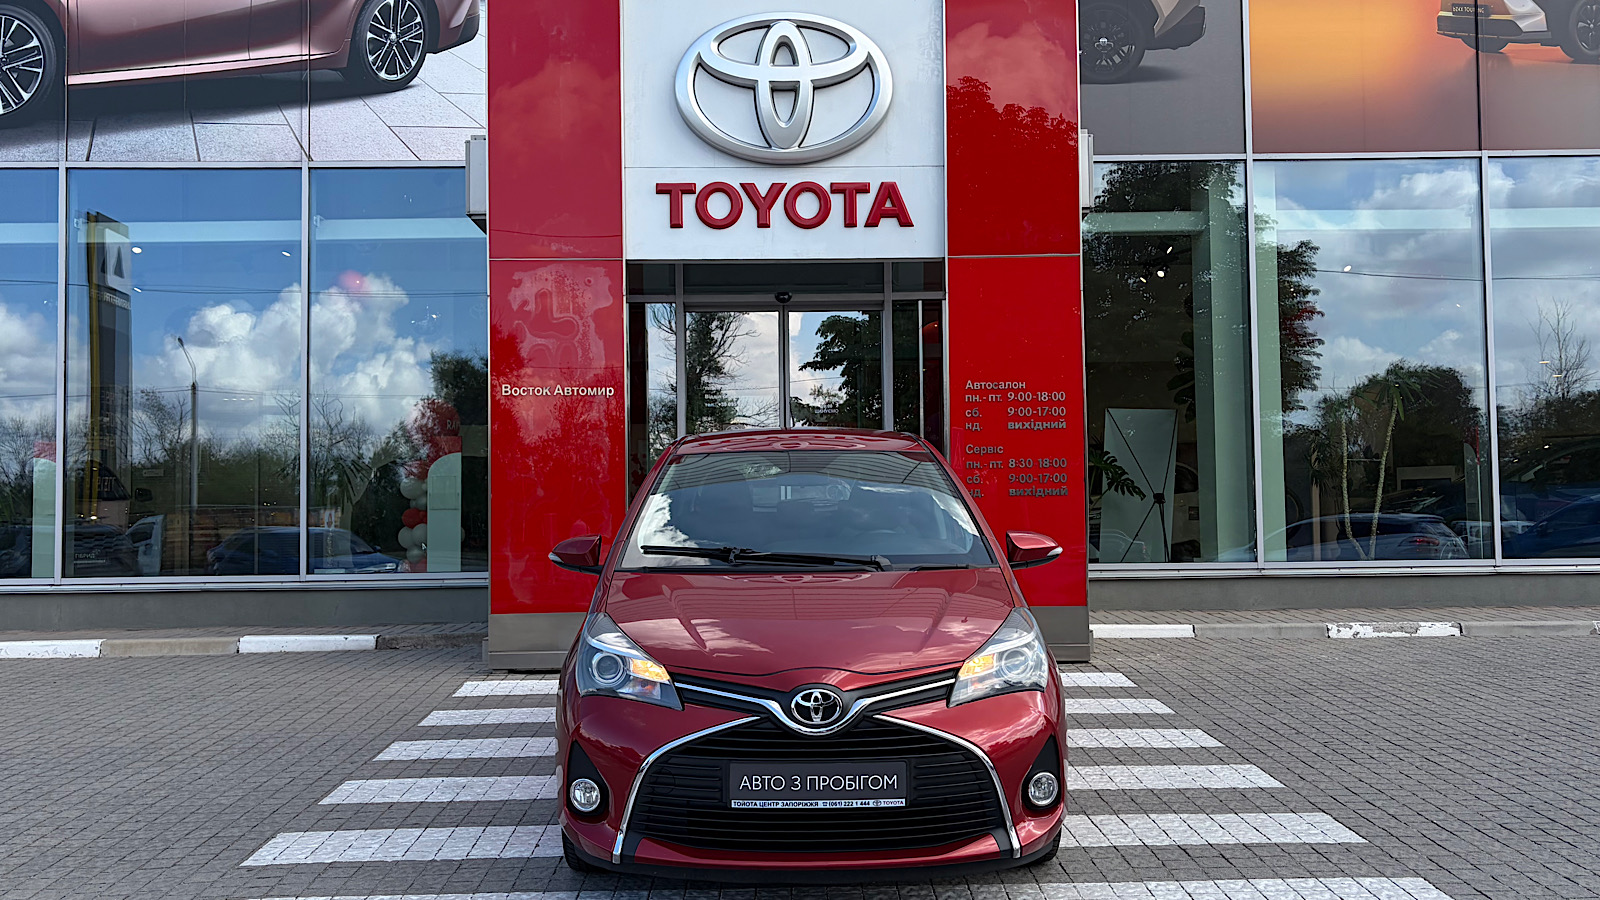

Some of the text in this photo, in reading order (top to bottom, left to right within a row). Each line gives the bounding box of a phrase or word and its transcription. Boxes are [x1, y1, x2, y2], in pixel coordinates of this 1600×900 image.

[655, 181, 914, 230] TOYOTA
[965, 380, 1026, 390] Автосалон
[501, 384, 615, 399] Восток Автомир
[965, 406, 1067, 417] сб. 9:00-17:00
[965, 419, 1067, 431] нд. вихідний
[965, 444, 1004, 456] Сервіс
[966, 474, 1068, 484] сб. 9:00-17:00
[1009, 485, 1069, 497] вихідний
[739, 774, 898, 791] АВТО З ПРОБІГОМ
